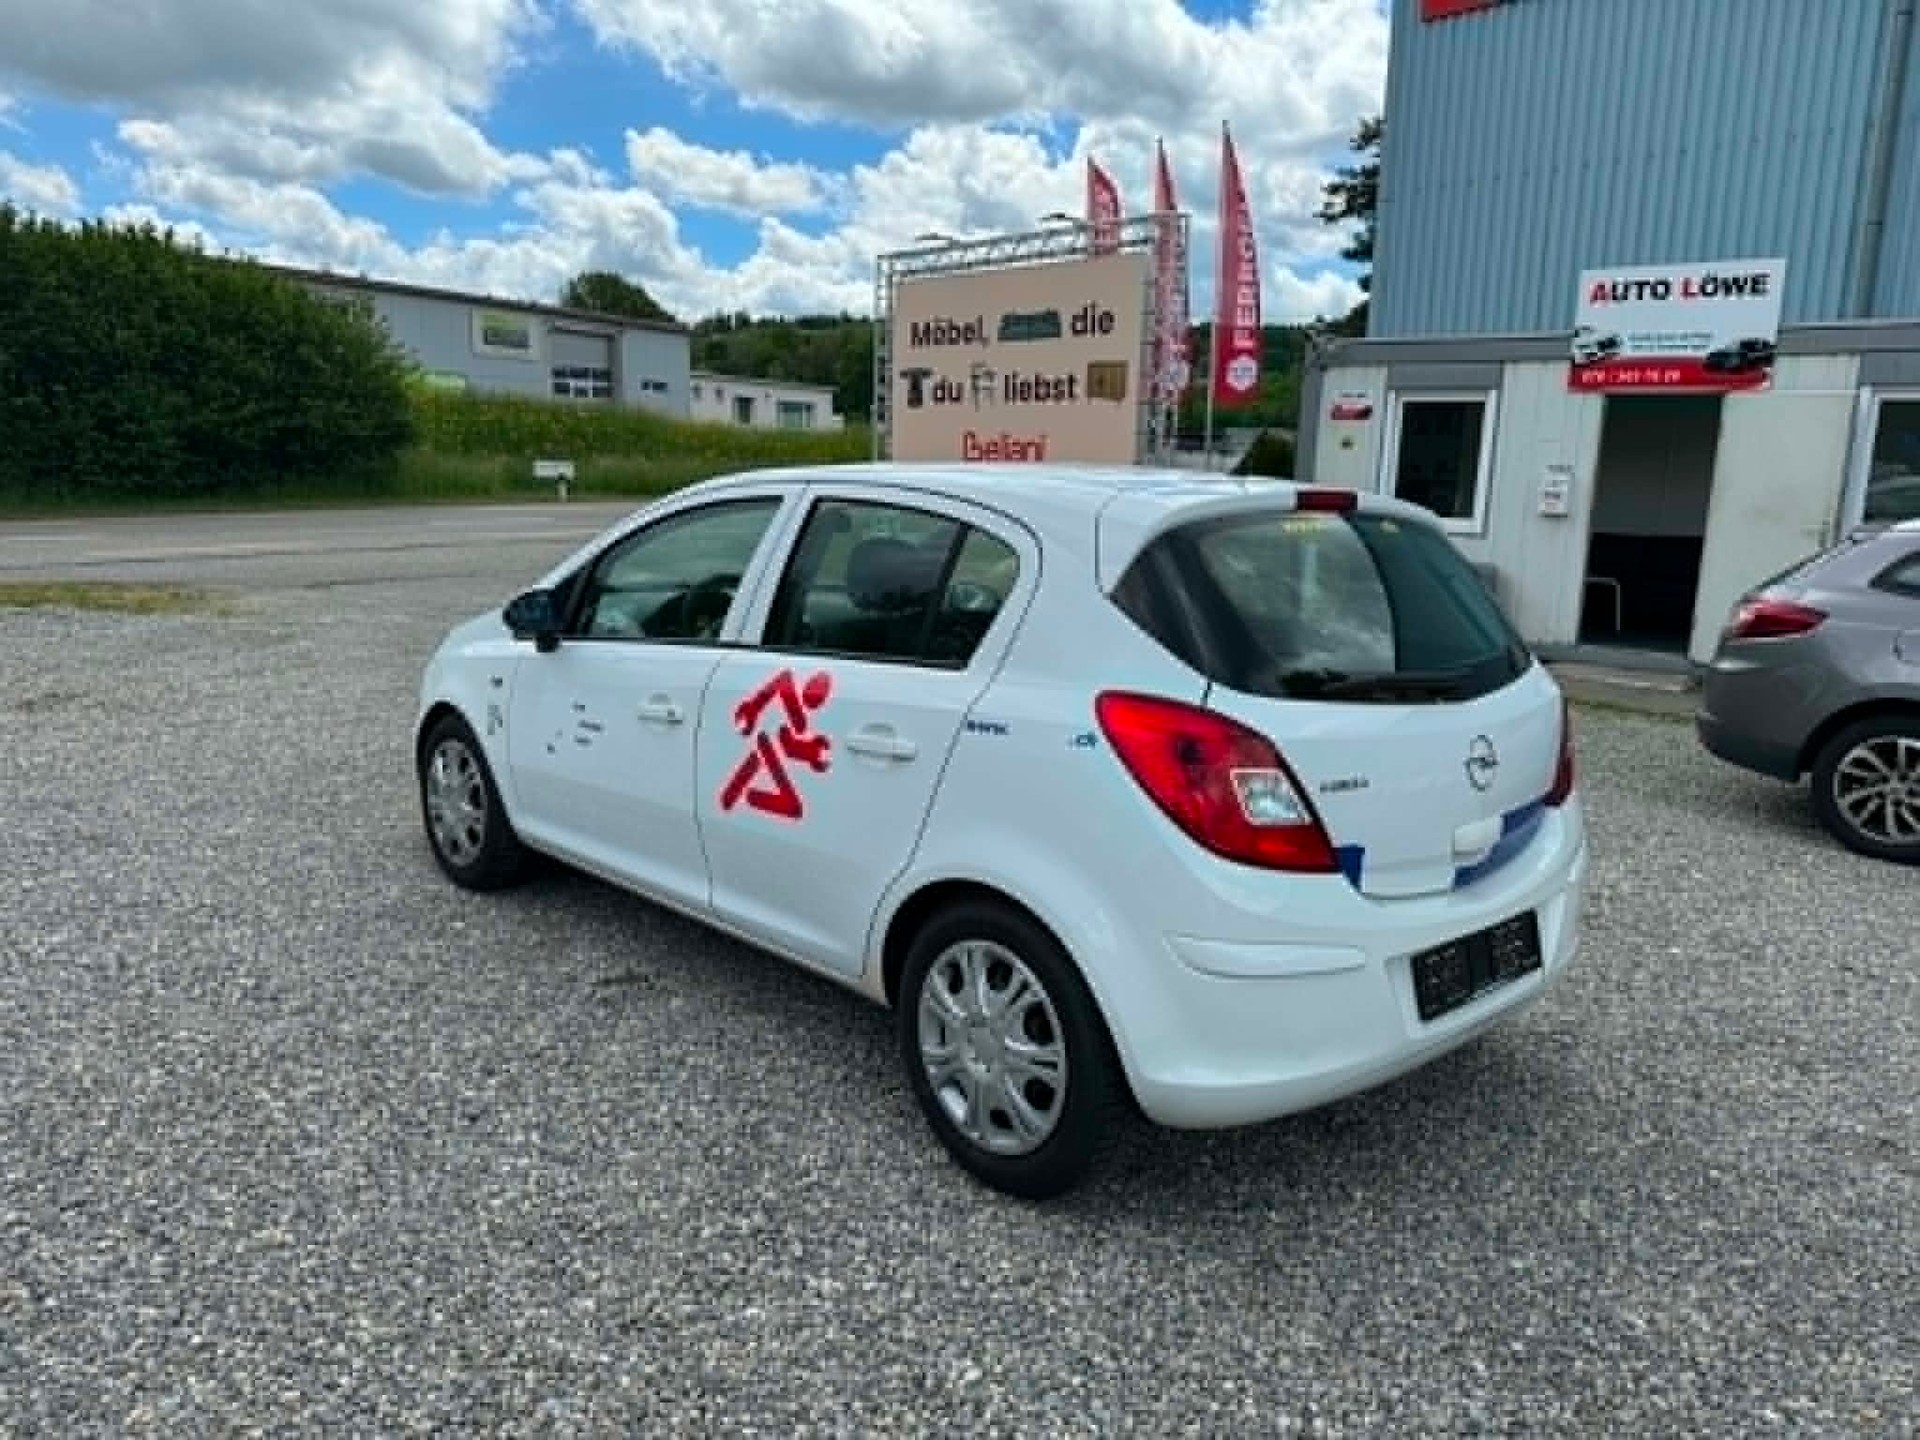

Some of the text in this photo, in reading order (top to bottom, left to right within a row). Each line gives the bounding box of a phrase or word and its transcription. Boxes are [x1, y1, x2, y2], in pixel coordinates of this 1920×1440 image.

[1590, 271, 1770, 302] AUTO LÖWE
[909, 302, 1115, 348] Möbel, die
[933, 371, 1079, 404] du liebst
